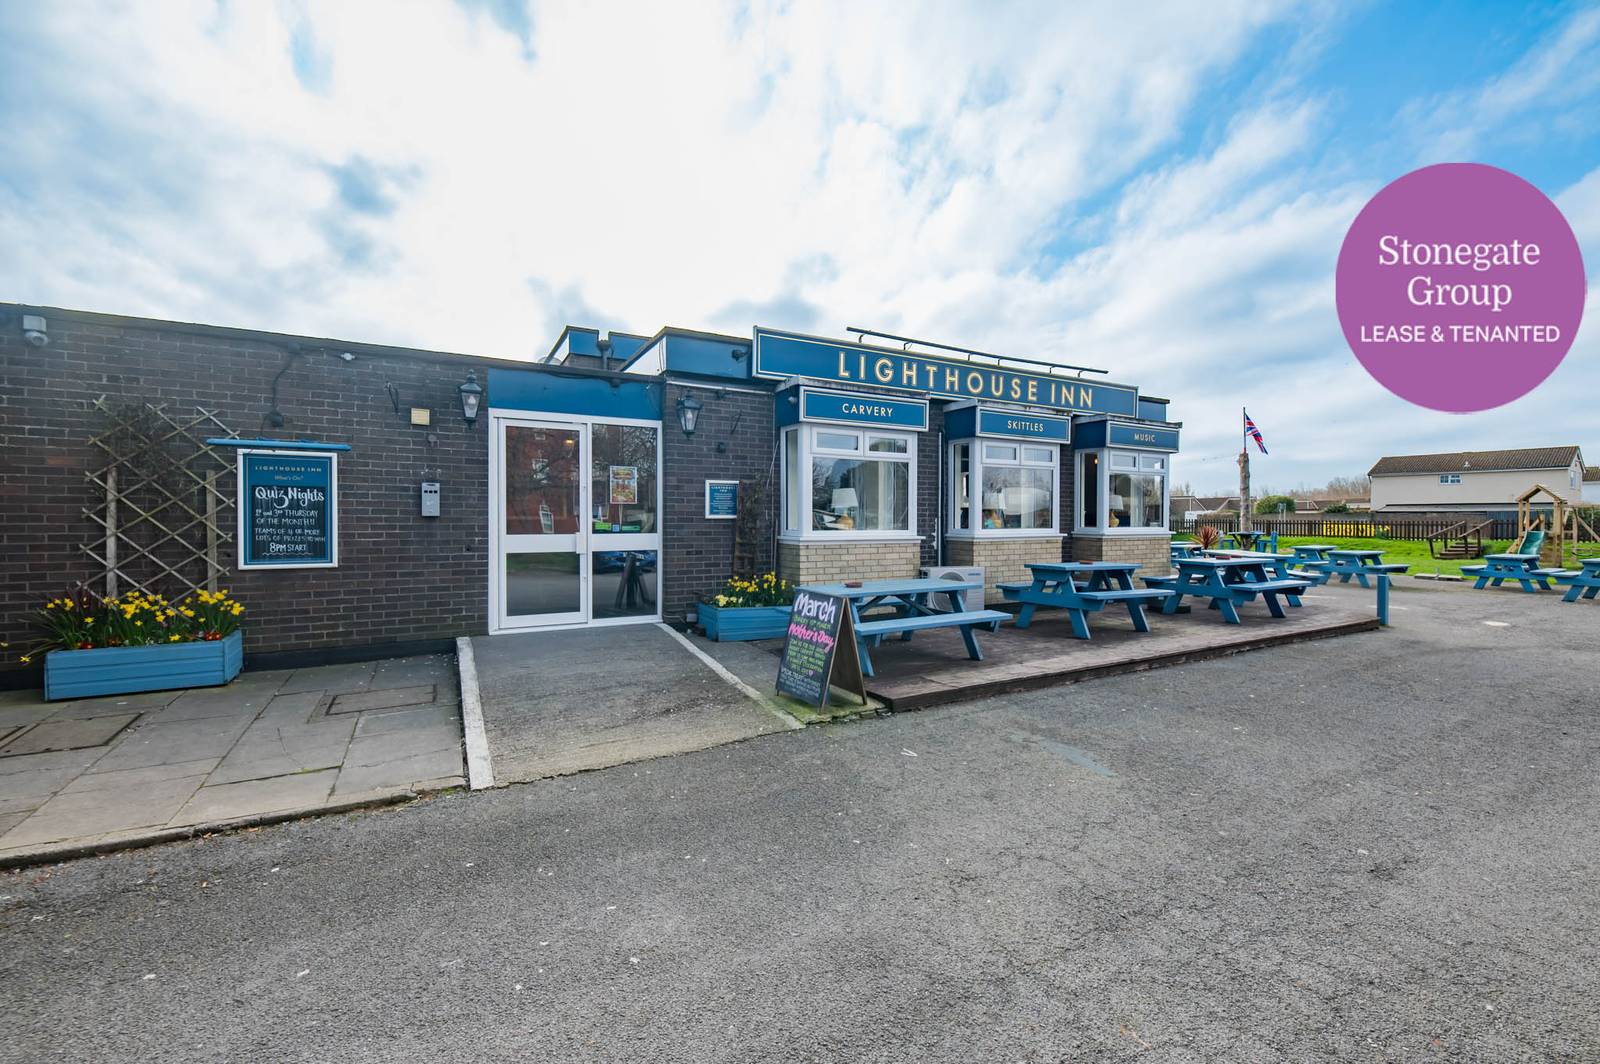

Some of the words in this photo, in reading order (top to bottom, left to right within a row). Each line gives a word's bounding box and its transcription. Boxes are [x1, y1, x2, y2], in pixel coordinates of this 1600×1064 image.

[837, 351, 1038, 402] LIGHTHOUSE
[1049, 382, 1094, 409] INN
[841, 403, 894, 418] CARVERY
[1006, 419, 1045, 433] SKITTLES
[1133, 432, 1156, 443] MUSIC
[255, 486, 289, 509] Quiz
[287, 486, 325, 507] Nights
[284, 509, 319, 518] THURSDAY
[269, 542, 287, 553] 8PM
[287, 543, 307, 552] START
[794, 593, 836, 623] March
[817, 630, 834, 653] Day
